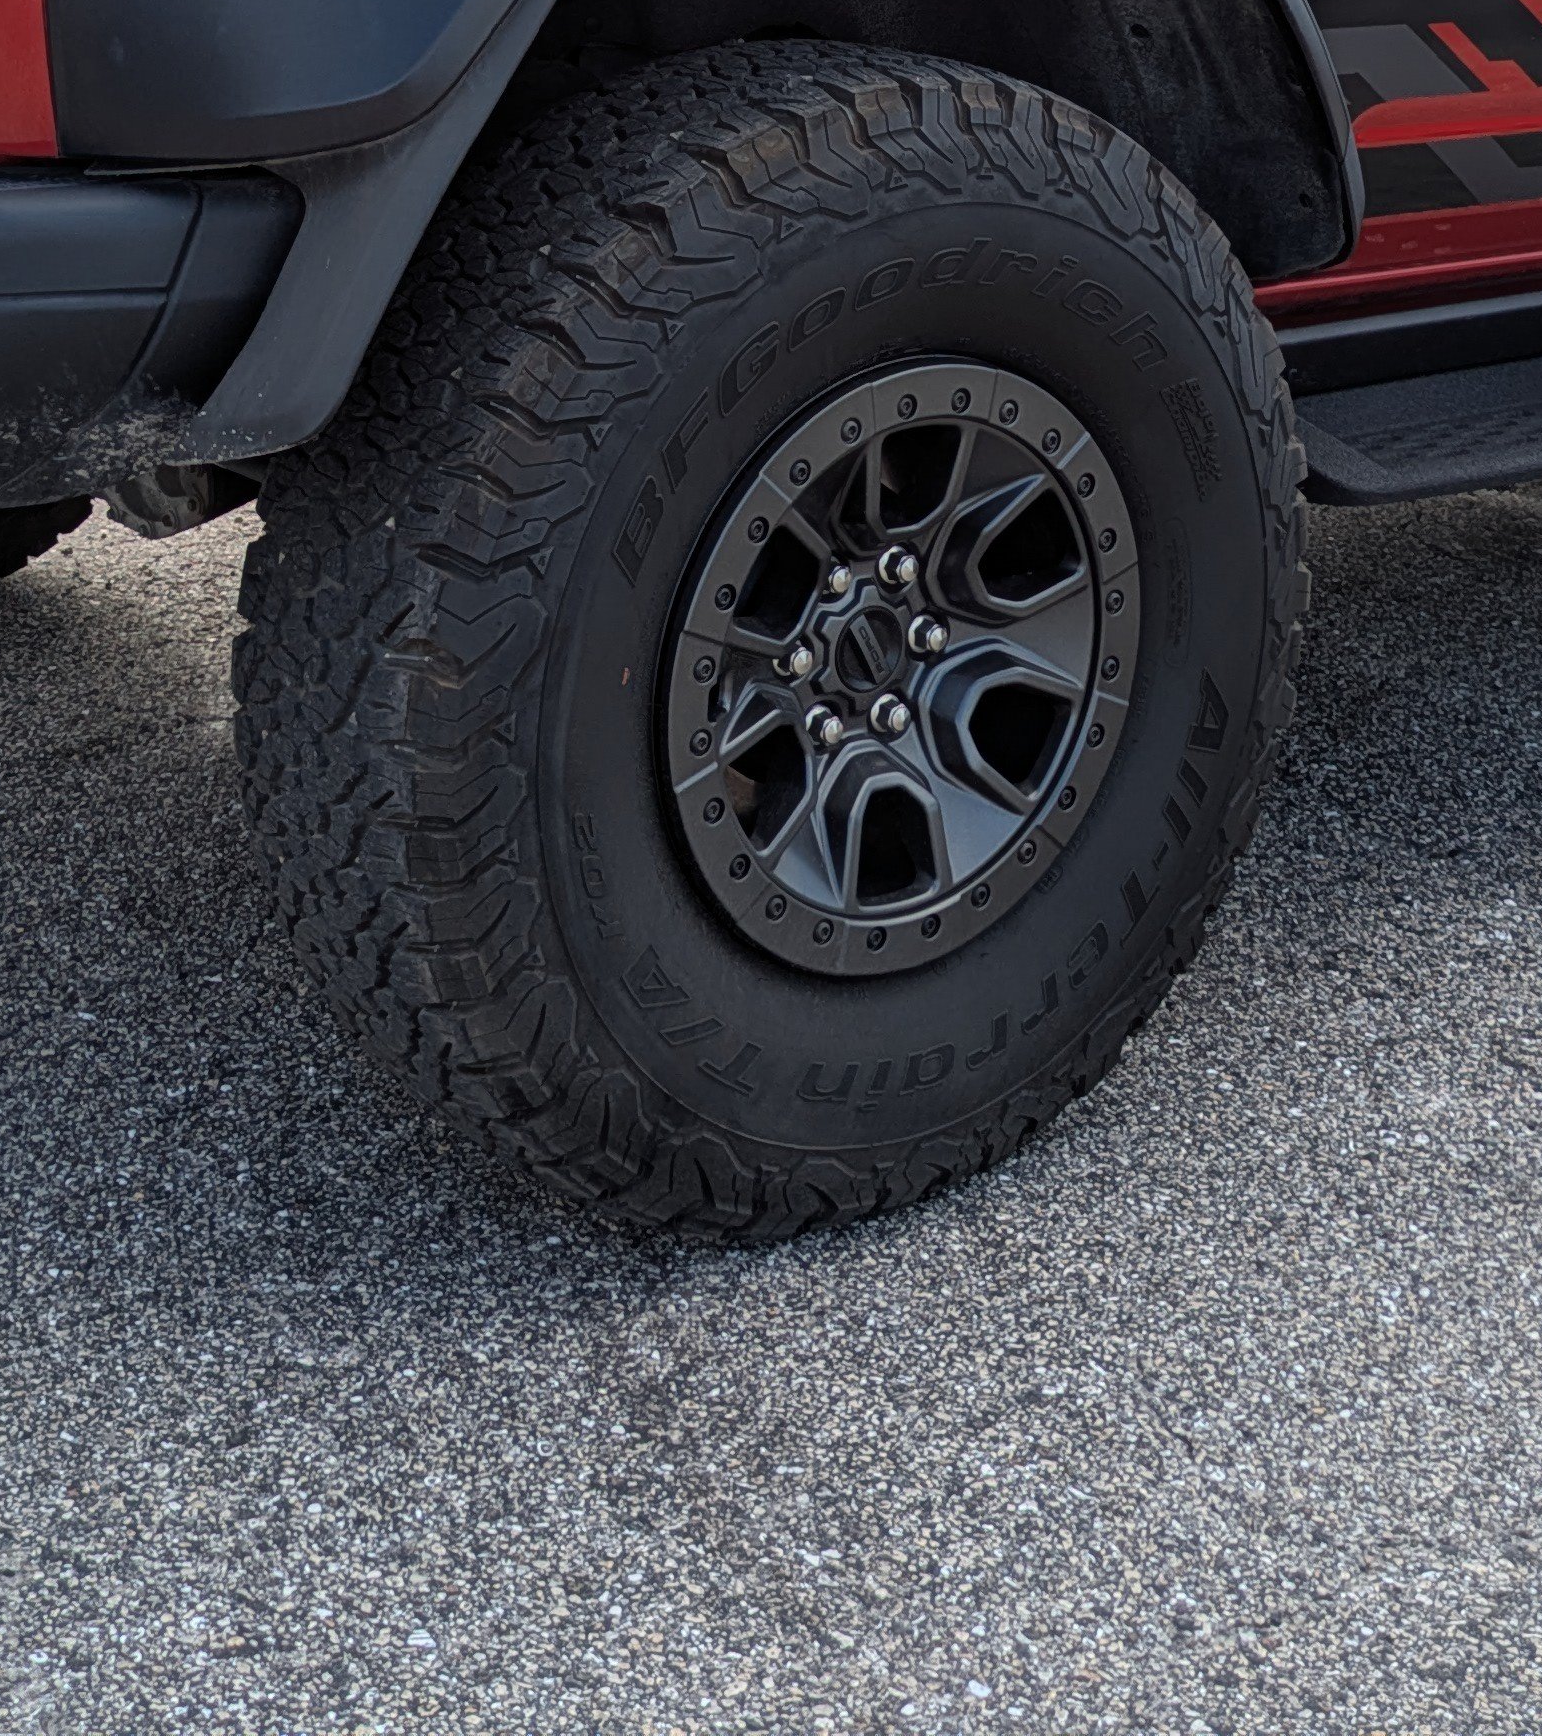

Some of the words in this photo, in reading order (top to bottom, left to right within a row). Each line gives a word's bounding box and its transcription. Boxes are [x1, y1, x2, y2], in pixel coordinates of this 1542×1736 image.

[611, 235, 1171, 587] BFGoodrich
[859, 625, 884, 674] FORD
[796, 667, 1231, 1112] All-Terrain
[620, 943, 765, 1100] T/A
